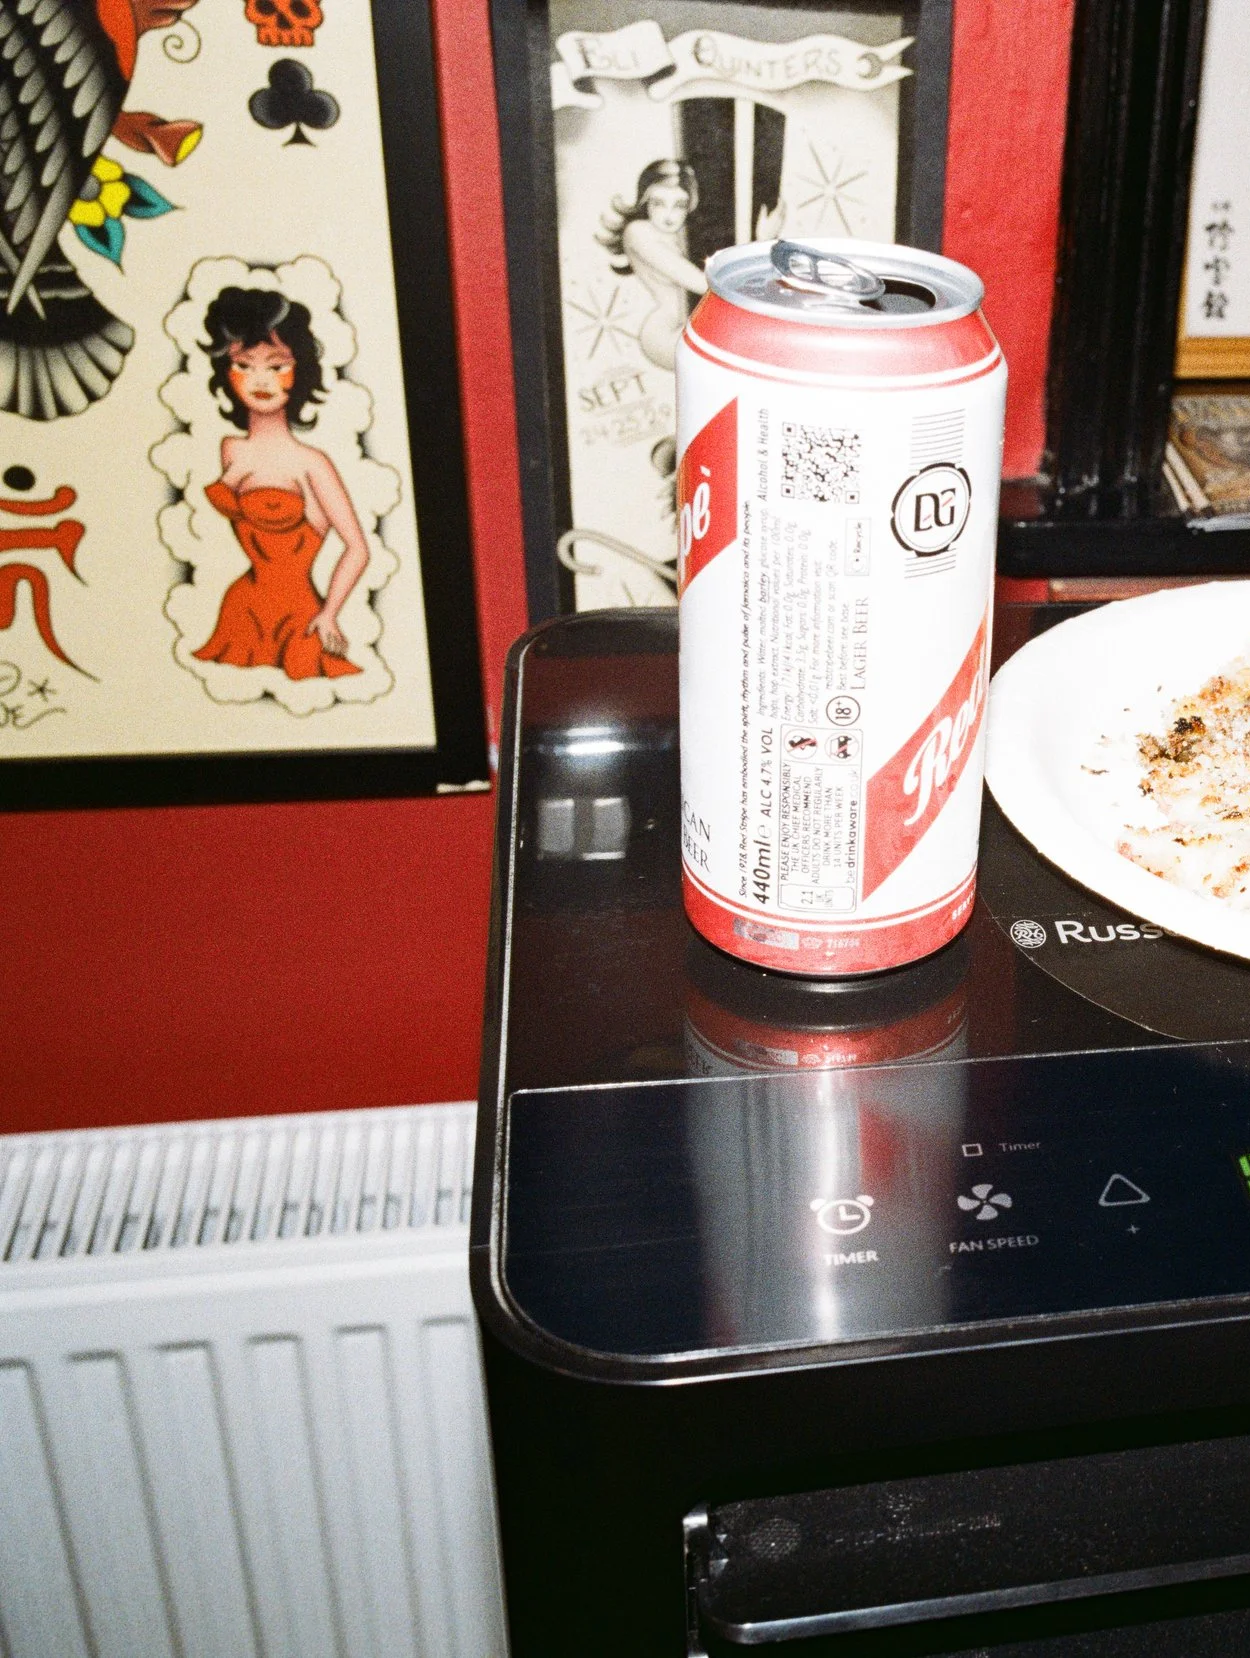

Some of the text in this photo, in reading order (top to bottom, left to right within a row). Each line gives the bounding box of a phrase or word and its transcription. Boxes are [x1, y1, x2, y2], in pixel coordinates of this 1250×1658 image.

[692, 34, 842, 79] QUINTERS
[577, 371, 647, 412] SEPT
[758, 408, 769, 444] Health
[756, 460, 768, 502] Alcohol
[740, 609, 750, 621] of
[812, 633, 820, 654] more
[741, 648, 749, 667] and
[741, 670, 750, 702] rhythm
[761, 728, 772, 754] VOL
[739, 746, 748, 789] embodied
[761, 760, 772, 786] 4.7%
[760, 790, 772, 817] ALC
[835, 786, 844, 809] WEEK
[740, 808, 749, 832] Stripe
[780, 762, 791, 881] PLEASE ENJOY RESPONSIBLY
[791, 776, 801, 872] THE UK CHIEF MEDICAL
[801, 776, 812, 874] OFFICERS RECOMMEND
[811, 767, 823, 884] ADULTS DO NOT REGULARLY
[823, 788, 832, 866] DRINK MORE THAN
[834, 813, 843, 827] PER
[739, 833, 747, 850] Red
[834, 831, 842, 855] UNITS
[739, 876, 747, 898] Since
[999, 1140, 1041, 1152] Timer
[950, 1234, 1040, 1254] FAN SPEED
[823, 1250, 879, 1267] TIMER
